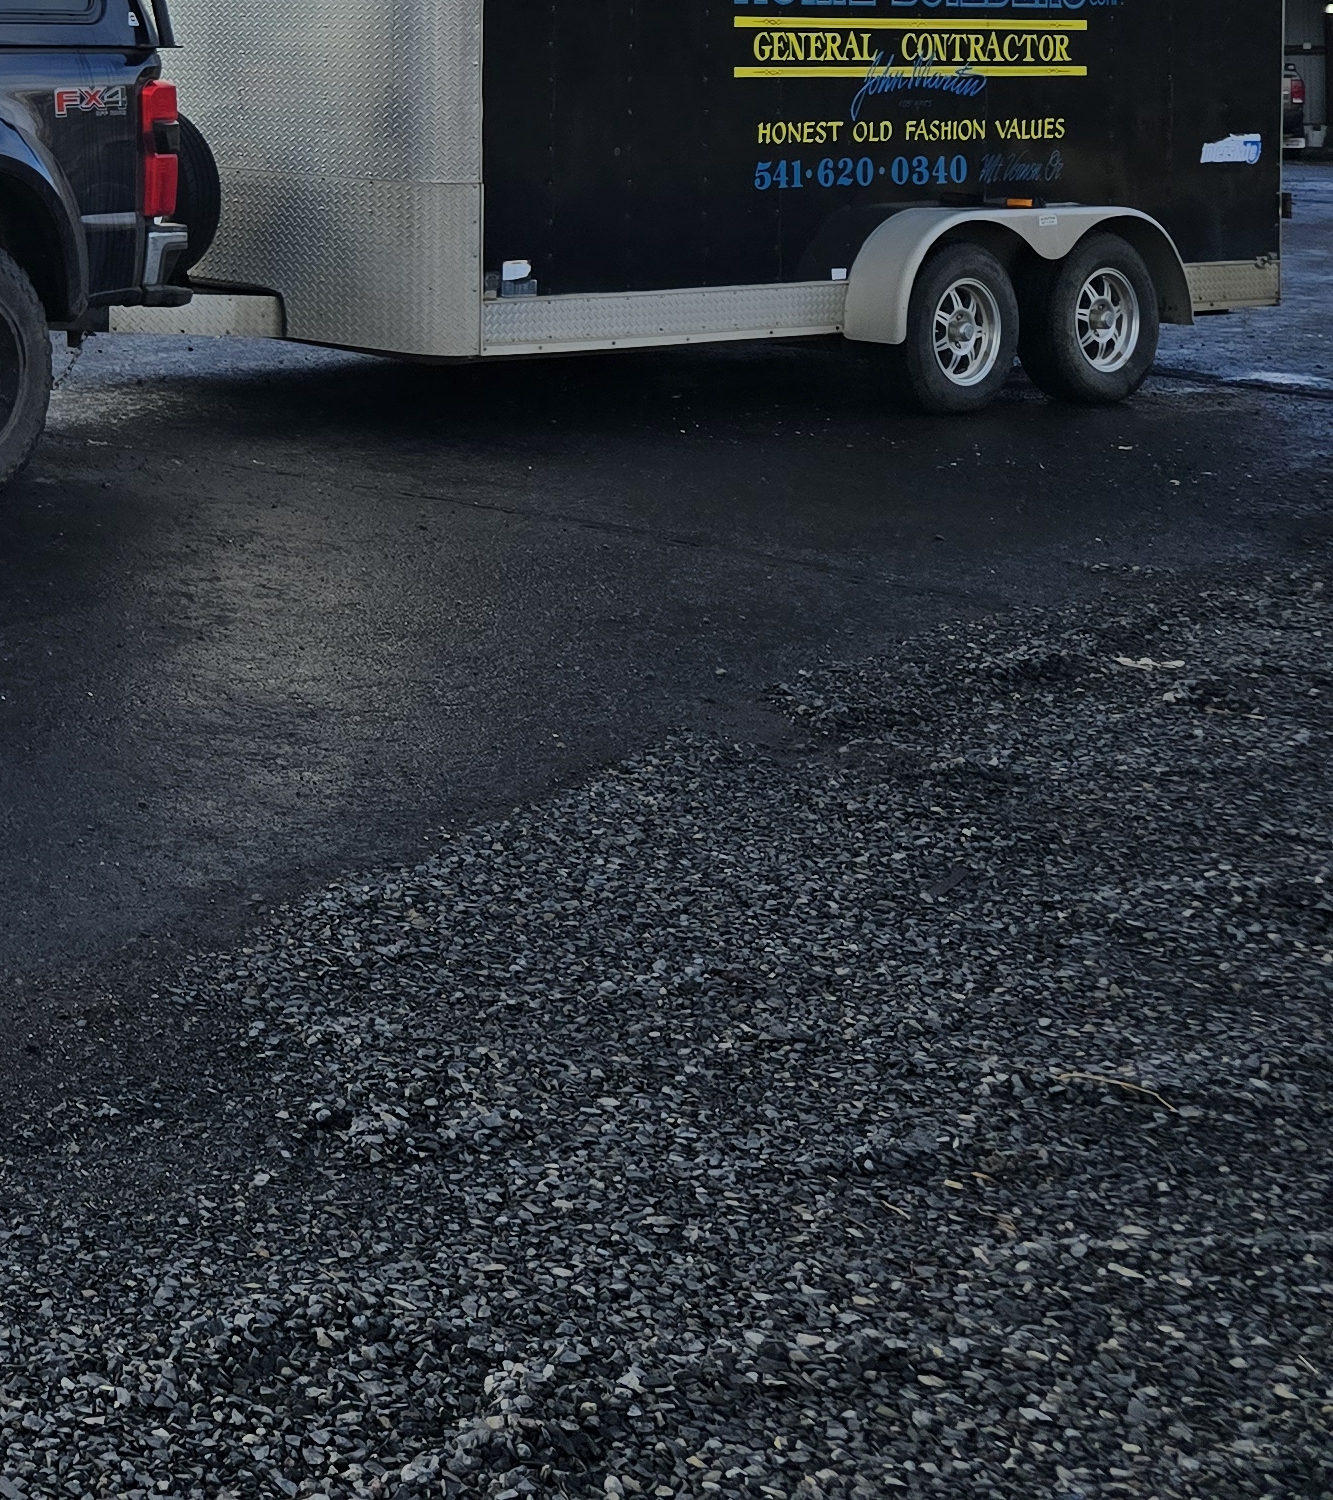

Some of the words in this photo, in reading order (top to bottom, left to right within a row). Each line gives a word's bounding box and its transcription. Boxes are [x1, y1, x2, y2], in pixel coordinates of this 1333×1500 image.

[753, 30, 878, 62] GENERAL
[901, 31, 1073, 62] CONTRACTOR
[55, 86, 128, 118] FX4
[757, 120, 844, 145] HONEST
[852, 120, 893, 143] OLD
[905, 118, 986, 141] FASHION
[994, 117, 1066, 139] VALUES
